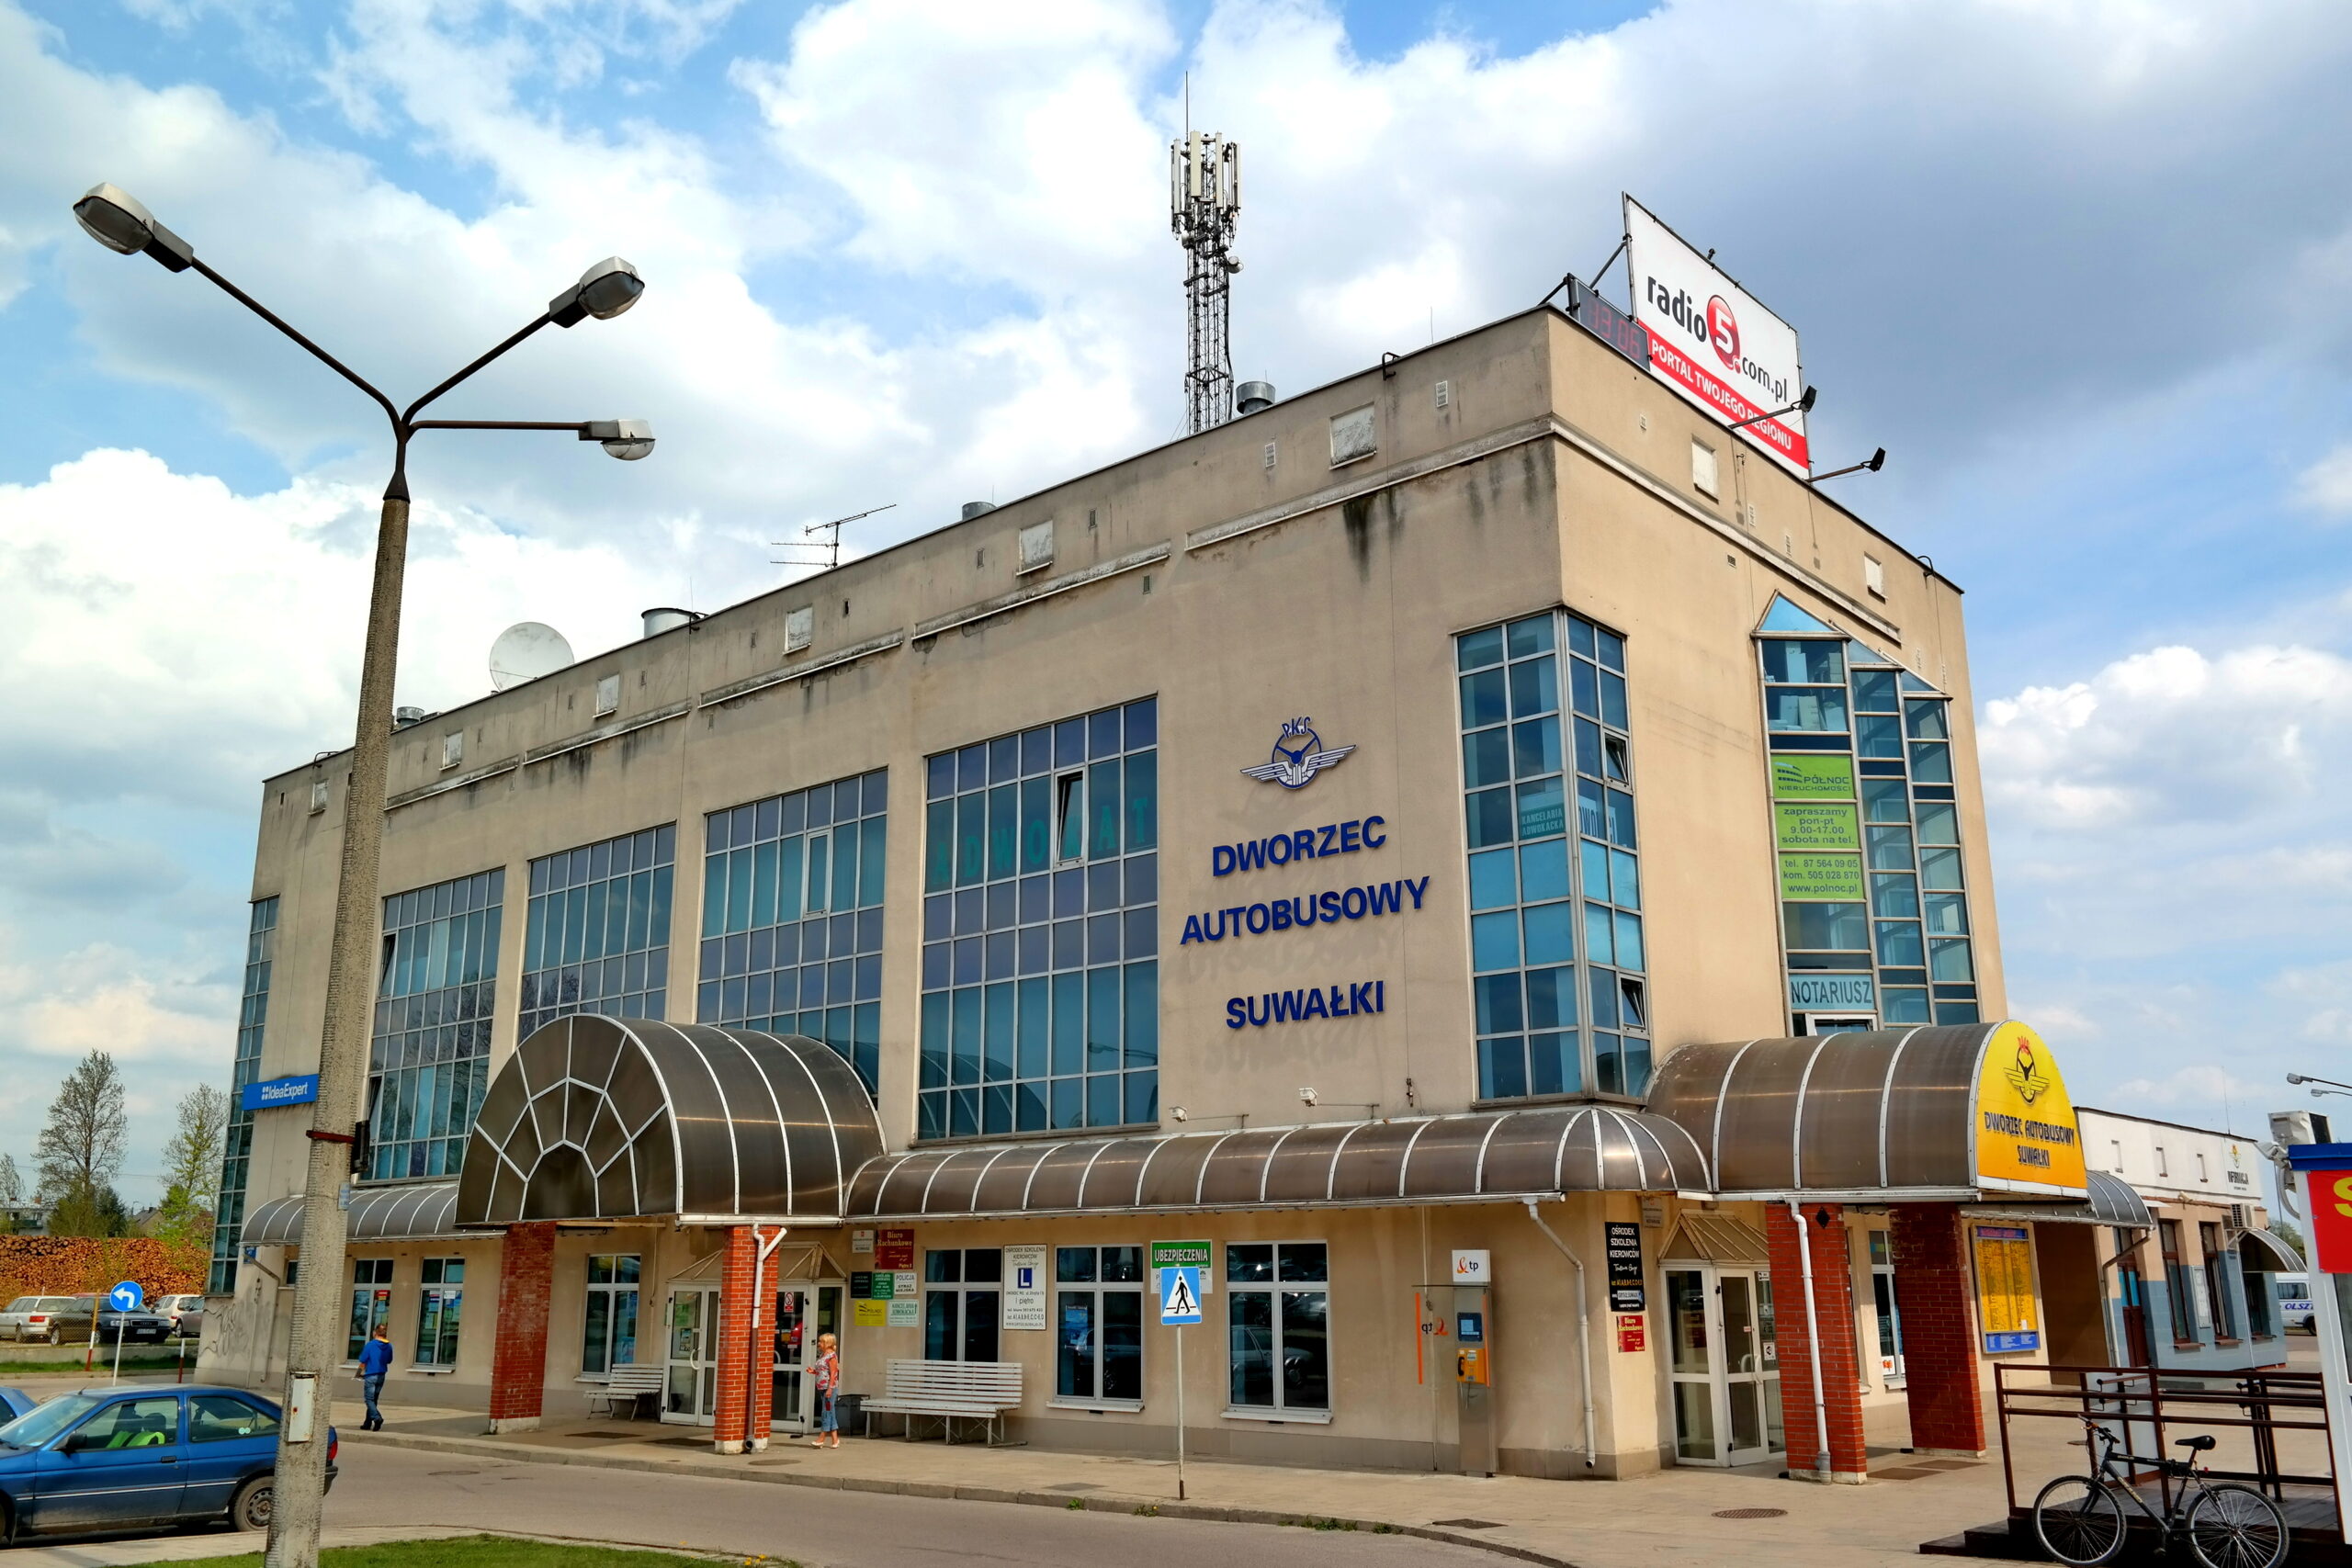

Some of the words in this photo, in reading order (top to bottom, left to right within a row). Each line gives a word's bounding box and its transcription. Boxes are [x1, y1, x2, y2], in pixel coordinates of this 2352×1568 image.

[1651, 339, 1694, 384] PORTAL
[1693, 369, 1746, 420] TWOJEGO
[1747, 408, 1792, 450] REGIONU
[1282, 716, 1311, 739] PKS
[1804, 773, 1849, 784] PÓŁNOC
[1521, 808, 1564, 826] KANCELARIA
[1783, 807, 1848, 817] zapraszamy
[1799, 817, 1835, 827] pon-pt
[1790, 826, 1845, 834] 9.00-17.00
[1782, 835, 1819, 844] sobota
[1822, 836, 1836, 844] na
[1838, 835, 1855, 844] tel.
[1212, 815, 1387, 877] DWORZEC
[1785, 859, 1799, 868] tel.
[1803, 859, 1815, 868] 87
[1816, 859, 1833, 868] 564
[1835, 859, 1845, 868] 09
[1847, 859, 1858, 868] 05
[1783, 871, 1805, 880] kom.
[1807, 871, 1824, 880] 505
[1826, 871, 1841, 880] 028
[1844, 871, 1860, 880] 870
[1788, 884, 1858, 894] www.polnoc.pl
[1180, 875, 1431, 945] AUTOBUSOWY
[1791, 979, 1872, 1004] NOTARIUSZ
[1226, 980, 1385, 1030] SUWAŁKI
[268, 1081, 309, 1100] IdeaExpert
[1984, 1111, 2023, 1136] DWORZEC
[2025, 1119, 2075, 1147] AUTOBUSOWY
[2017, 1145, 2051, 1168] SUWAŁKI
[887, 1231, 903, 1239] Biuro
[1611, 1224, 1635, 1235] OŚRODEK
[1610, 1238, 1637, 1247] SZKOLENIA
[1155, 1248, 1208, 1262] UBEZPIECZENIA
[1610, 1248, 1640, 1258] KIEROWCÓW
[1469, 1260, 1479, 1271] tp
